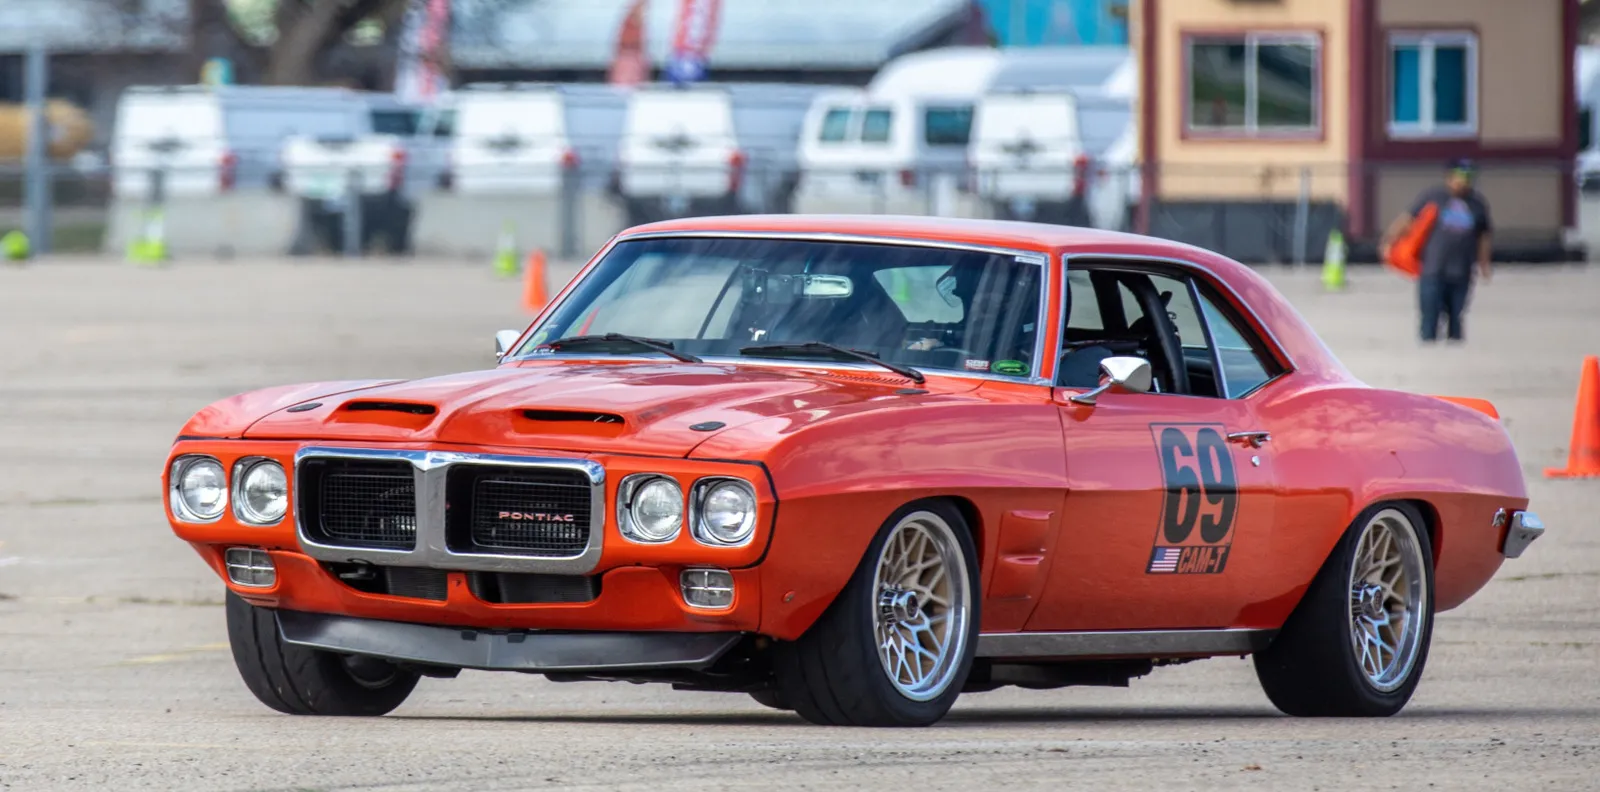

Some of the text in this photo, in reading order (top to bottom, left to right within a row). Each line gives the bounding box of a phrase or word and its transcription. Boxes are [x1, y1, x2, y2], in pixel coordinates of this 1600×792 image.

[1160, 427, 1237, 544] 69
[498, 511, 574, 522] PONTIAC
[1178, 546, 1225, 574] CAM-T
